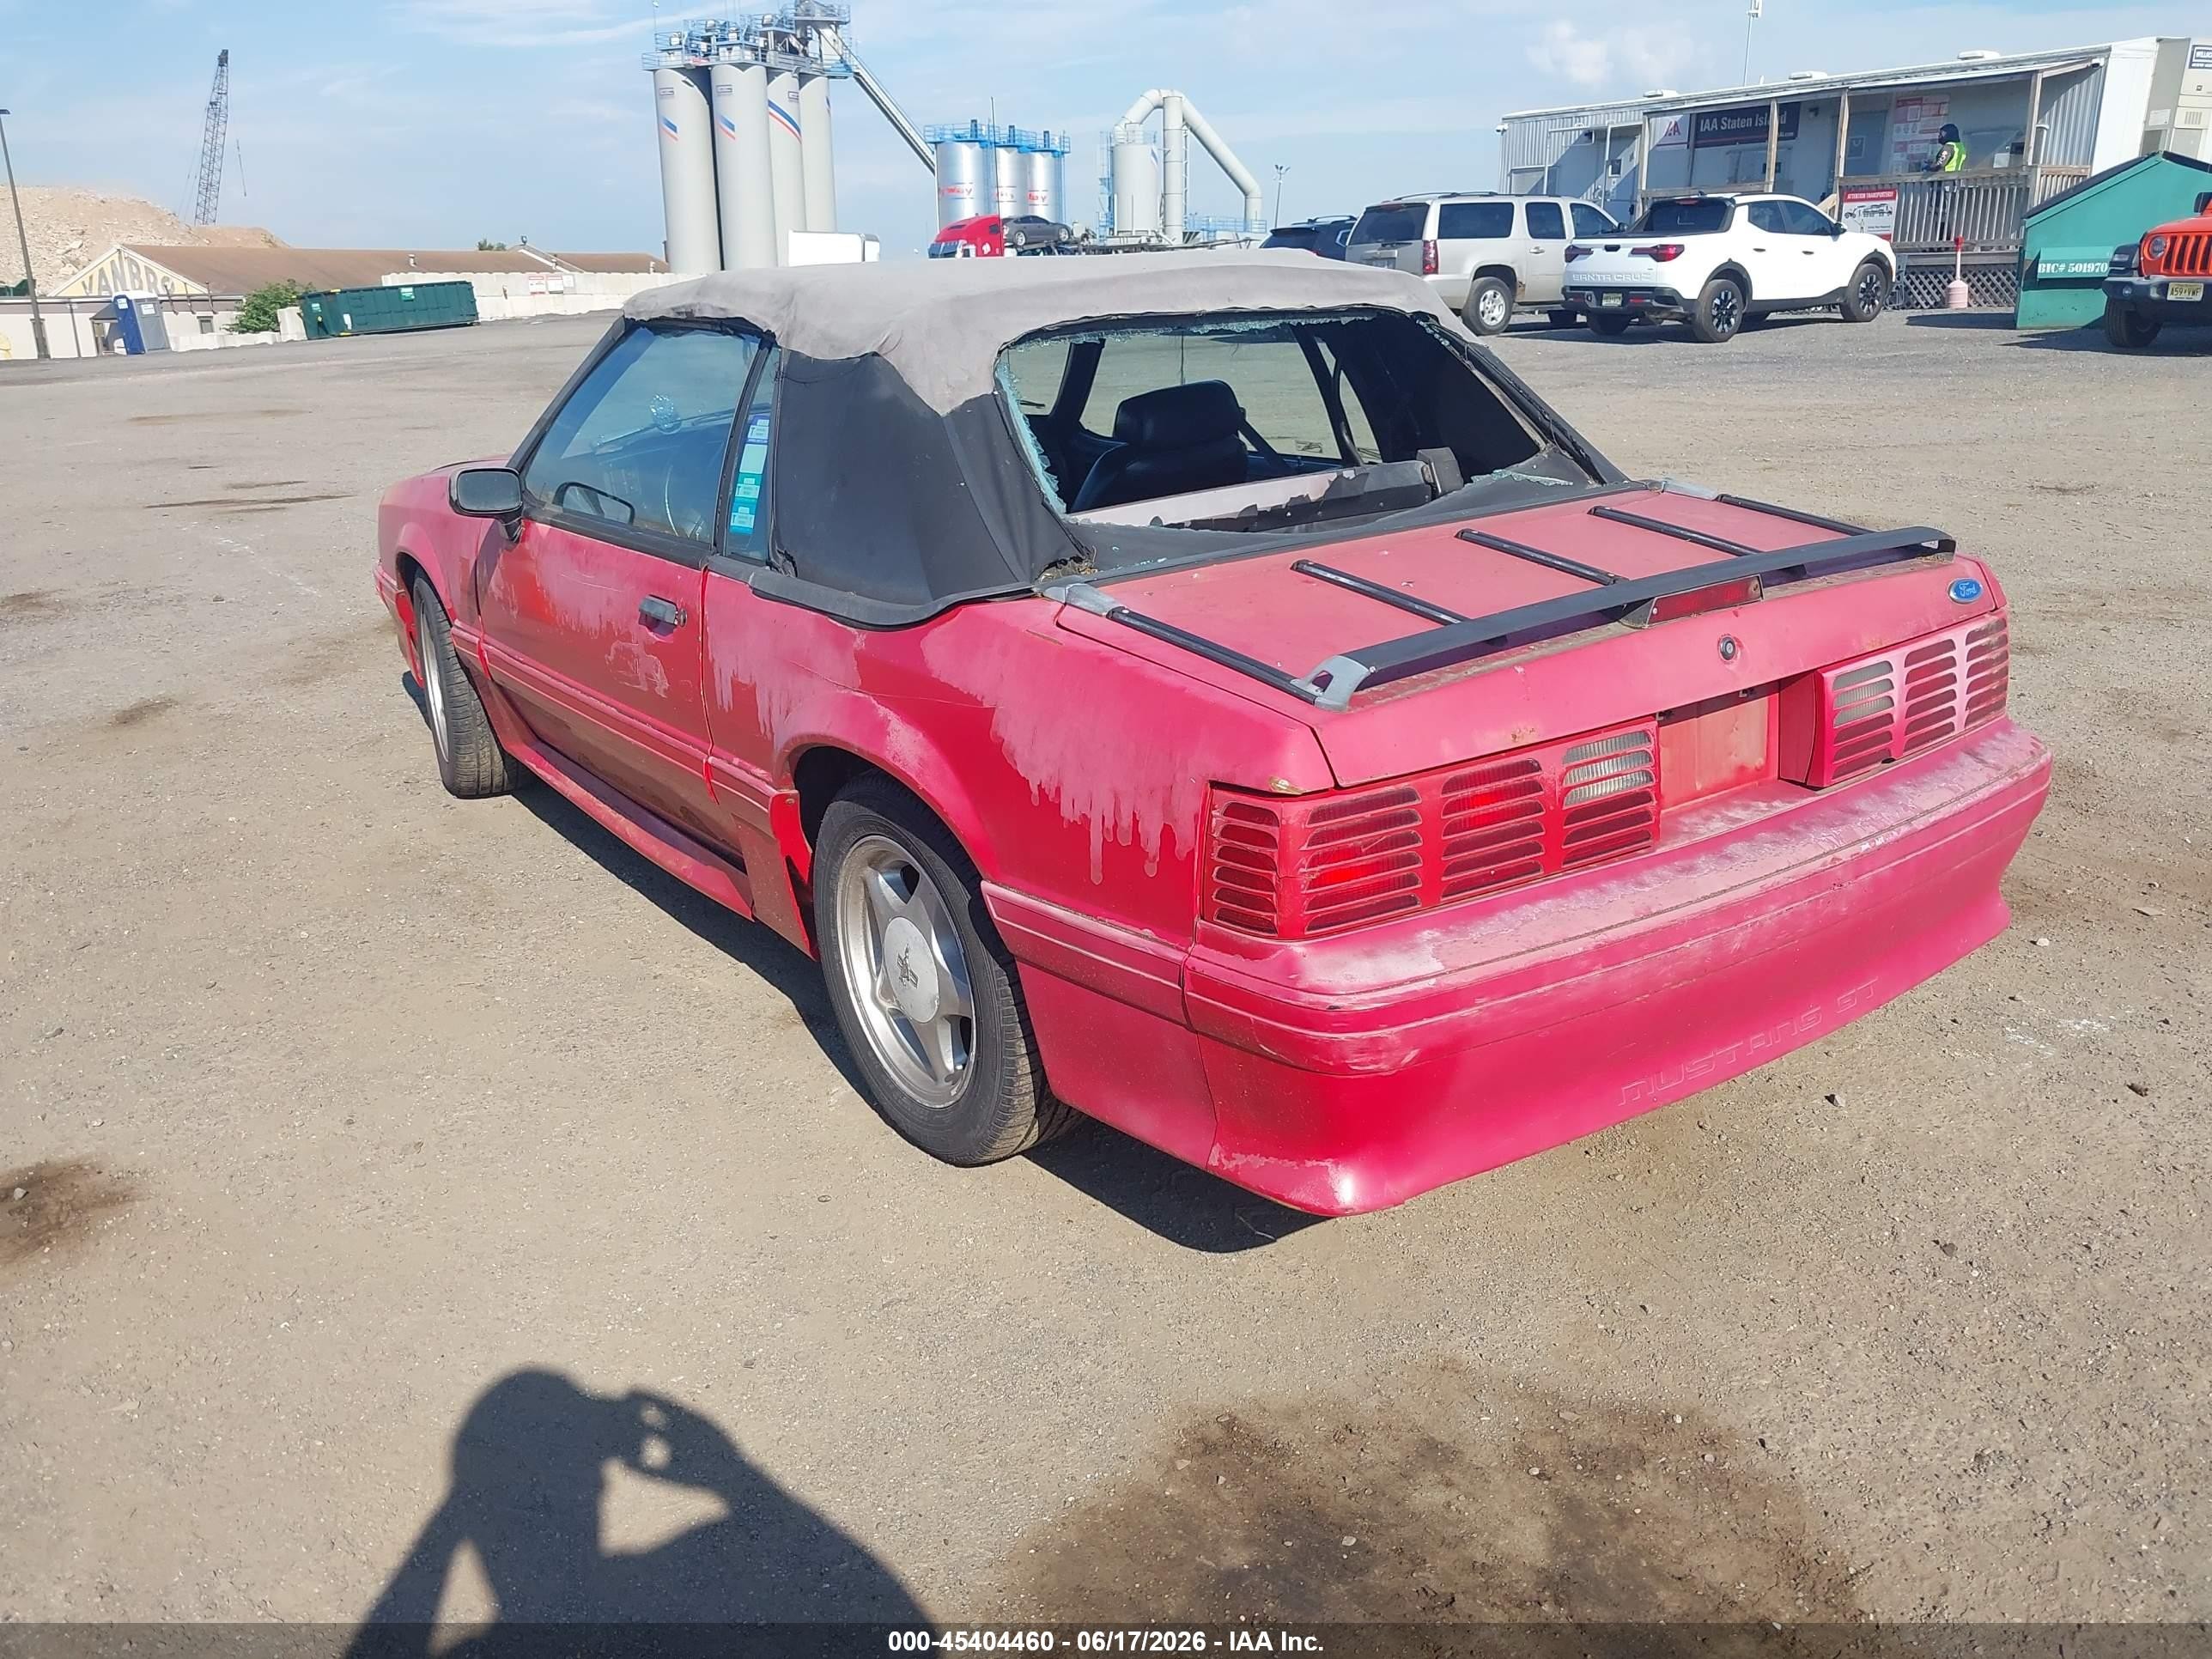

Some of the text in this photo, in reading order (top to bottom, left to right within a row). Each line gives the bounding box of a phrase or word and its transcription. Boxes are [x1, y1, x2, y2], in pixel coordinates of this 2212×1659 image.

[1700, 119, 1718, 131] IAA
[1721, 116, 1752, 130] Staten
[2068, 262, 2108, 273] 501970
[1959, 581, 1978, 598] Ford
[1618, 976, 1879, 1106] MUSTANG GT
